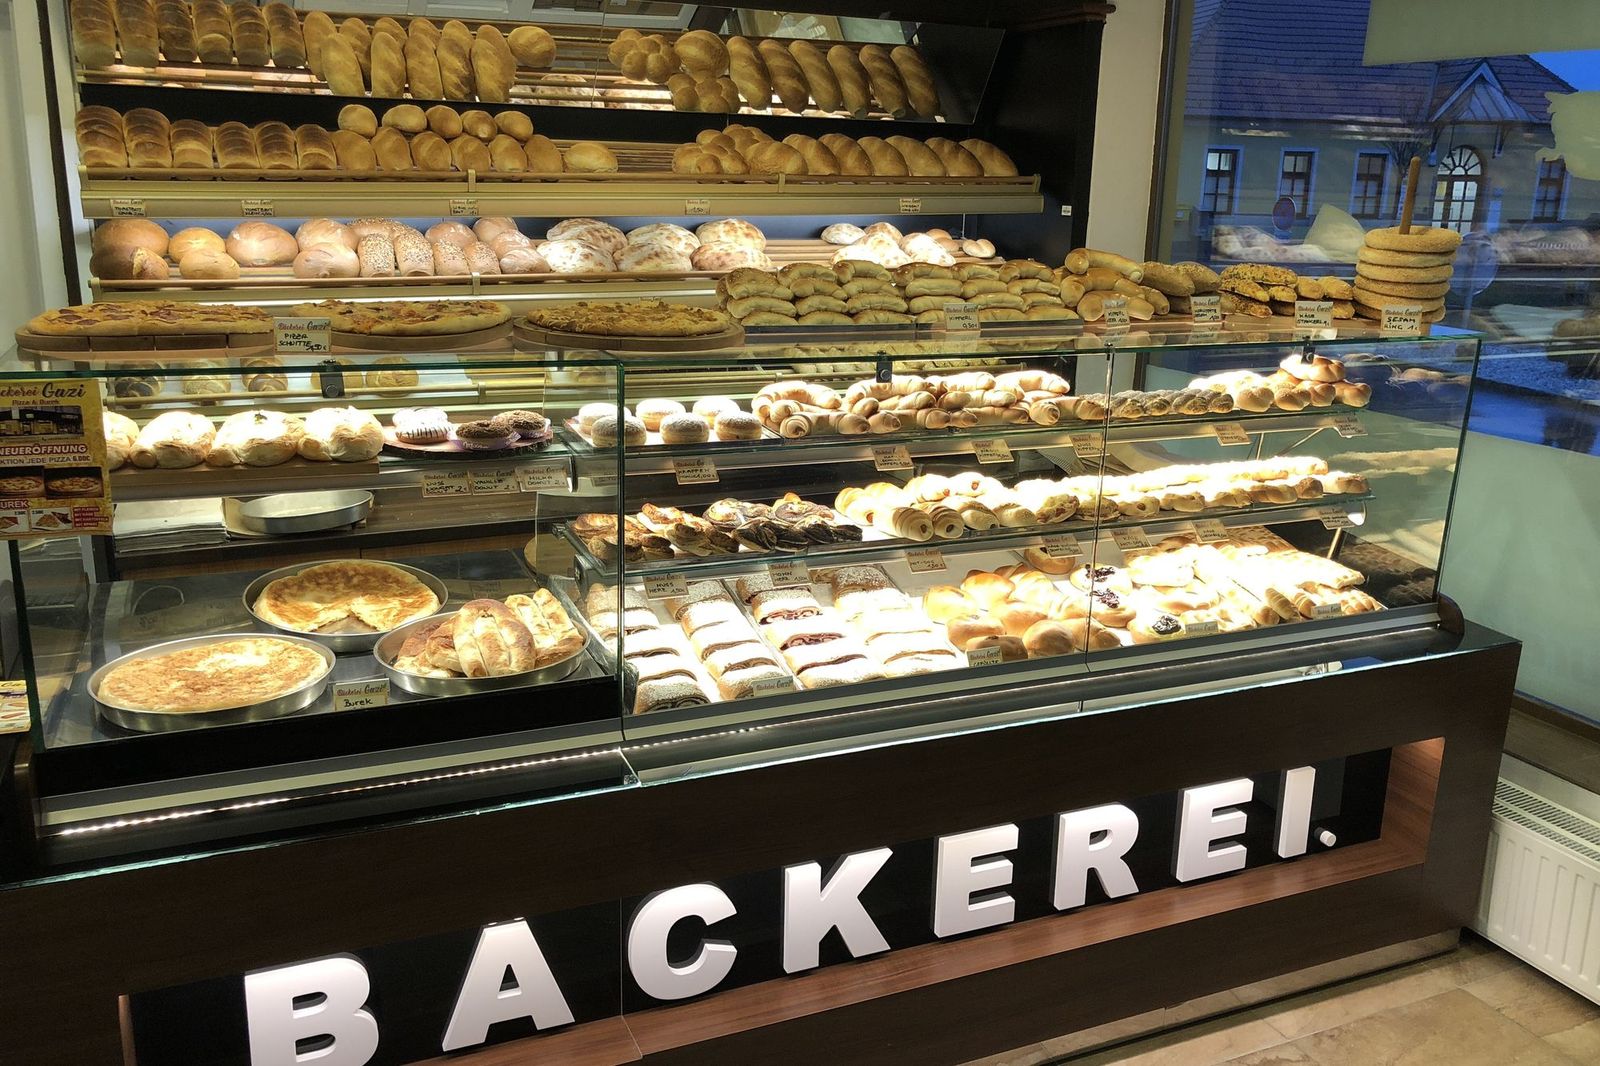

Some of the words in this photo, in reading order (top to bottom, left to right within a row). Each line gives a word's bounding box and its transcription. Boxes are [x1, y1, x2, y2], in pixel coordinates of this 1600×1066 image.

[284, 332, 309, 340] PIZZA
[42, 382, 86, 398] Gazi
[343, 697, 373, 708] Burek
